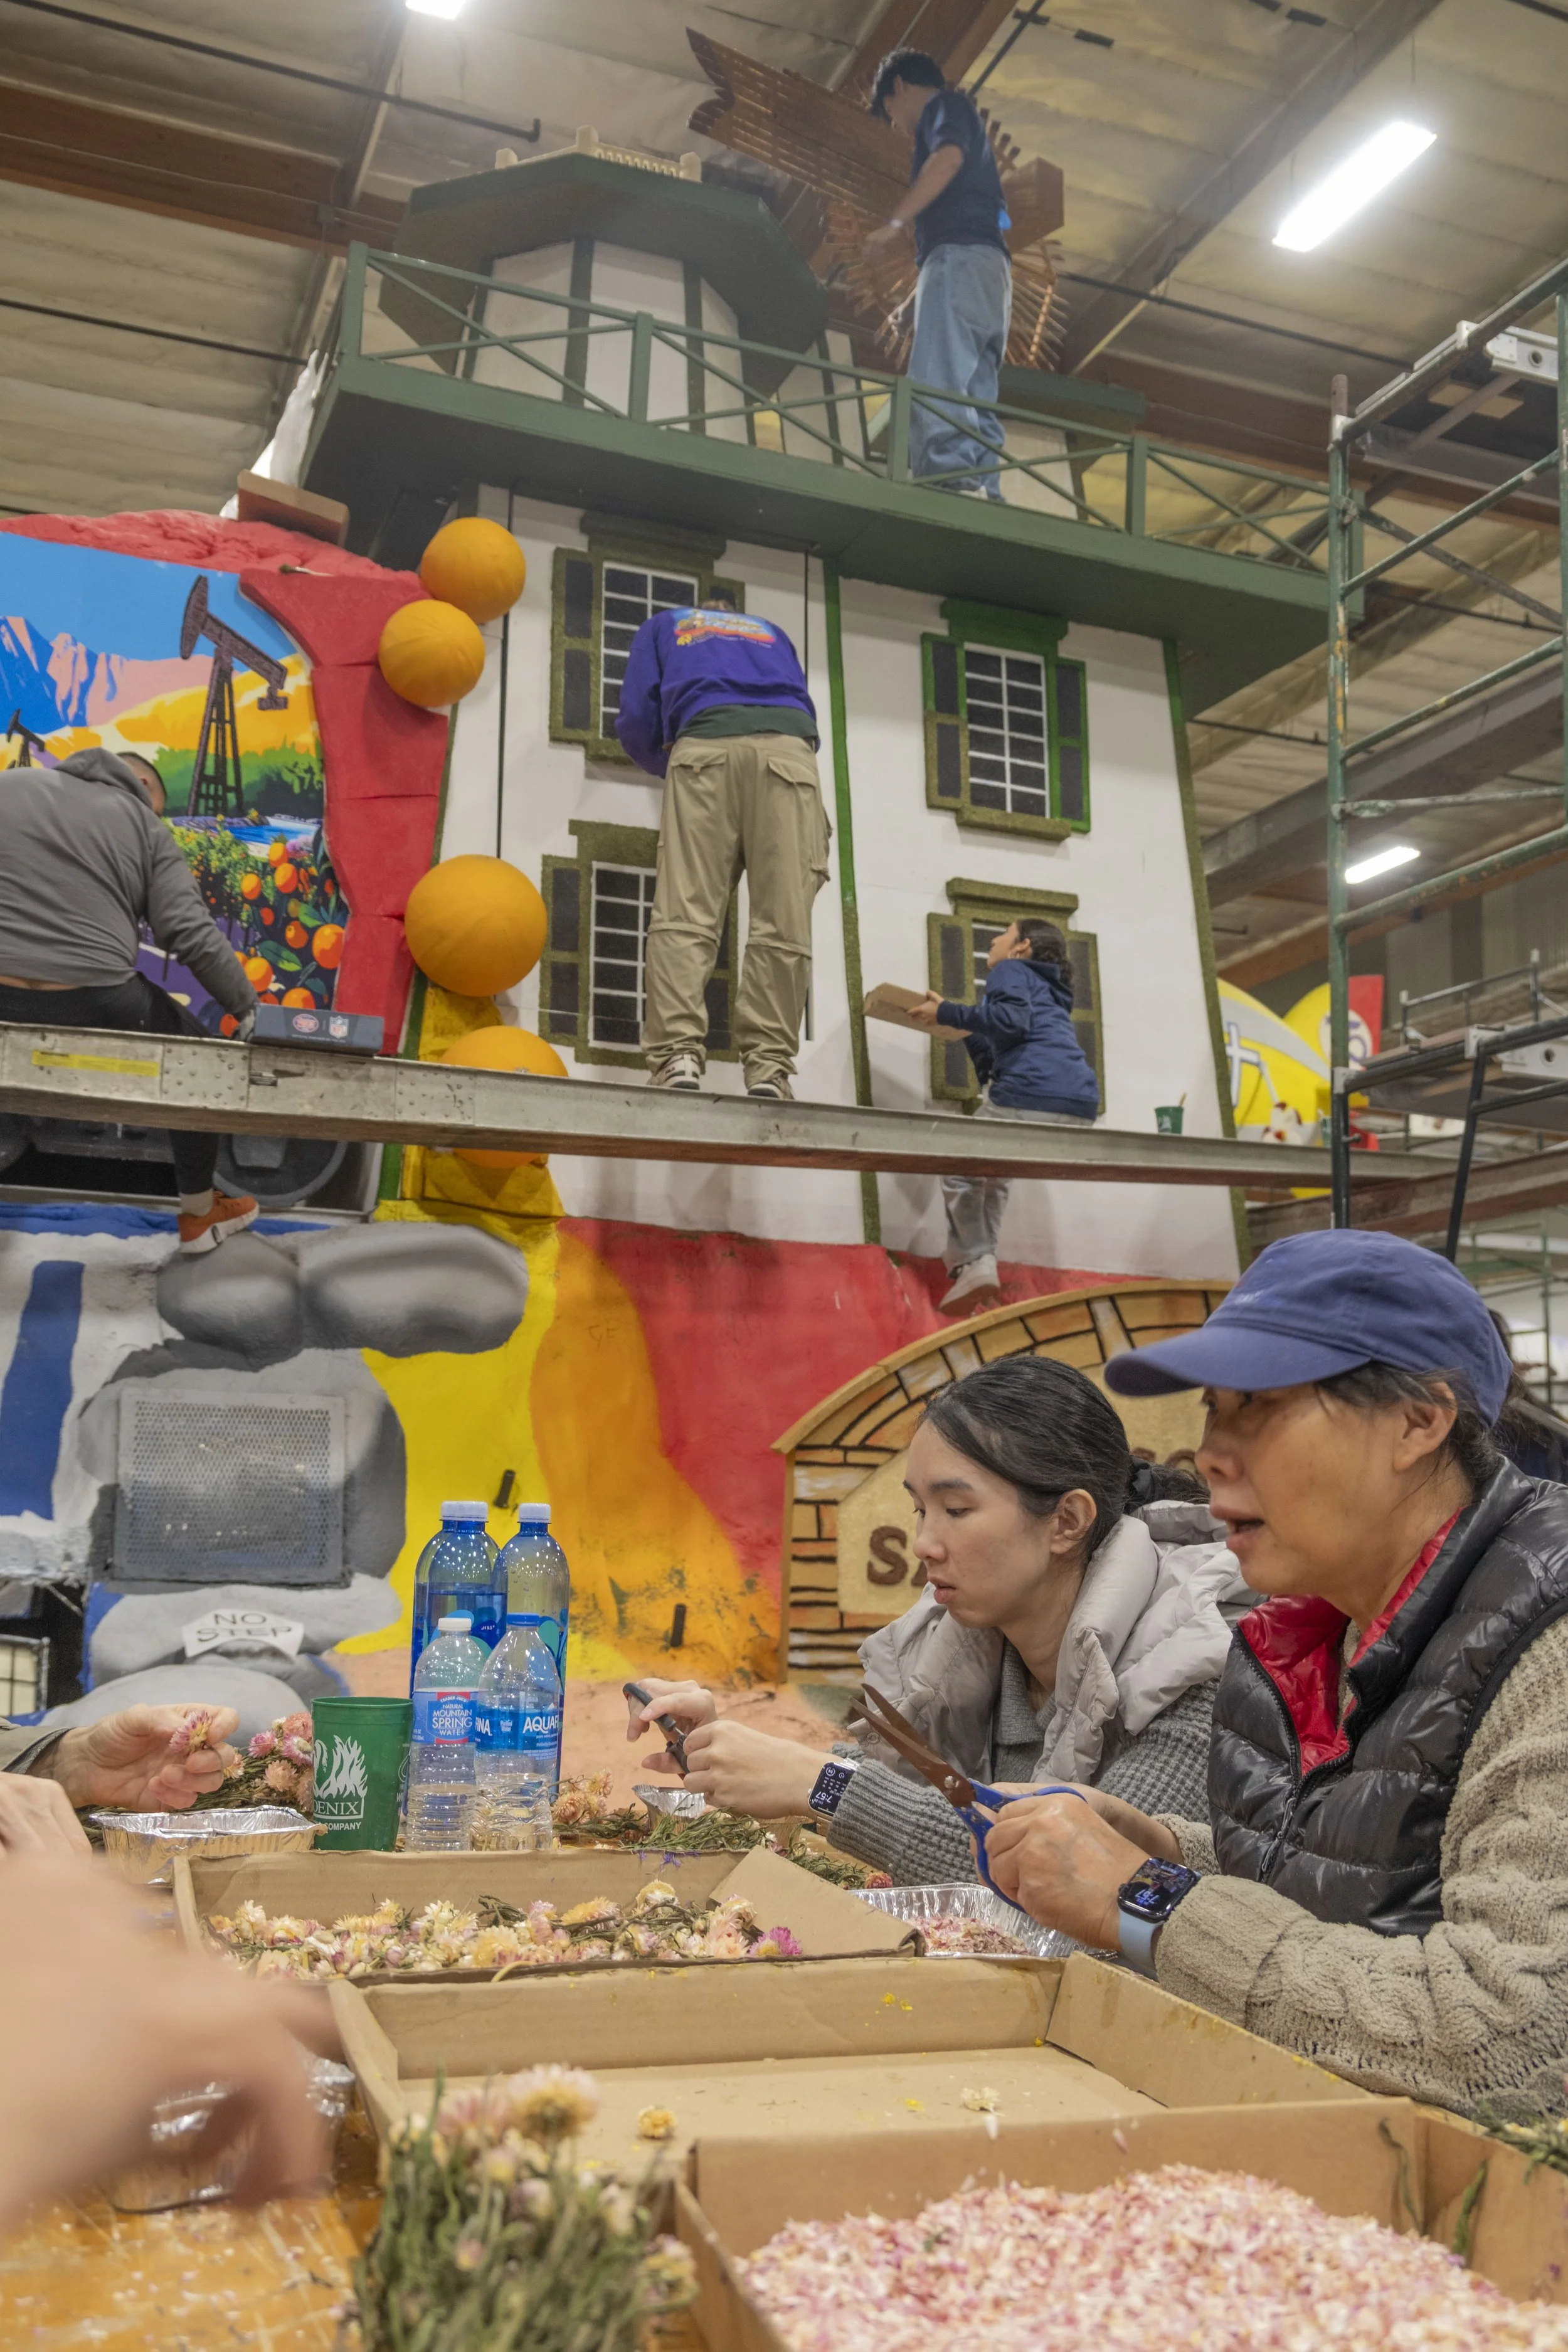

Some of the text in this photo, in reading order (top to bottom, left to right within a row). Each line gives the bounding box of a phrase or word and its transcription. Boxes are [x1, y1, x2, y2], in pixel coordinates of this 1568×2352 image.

[213, 1613, 267, 1625] NO
[196, 1626, 292, 1642] STEP
[433, 1709, 472, 1717] MOUNTAIN
[432, 1717, 473, 1729] SPRING
[815, 1791, 832, 1803] 7:57
[1135, 1889, 1160, 1904] 7:57
